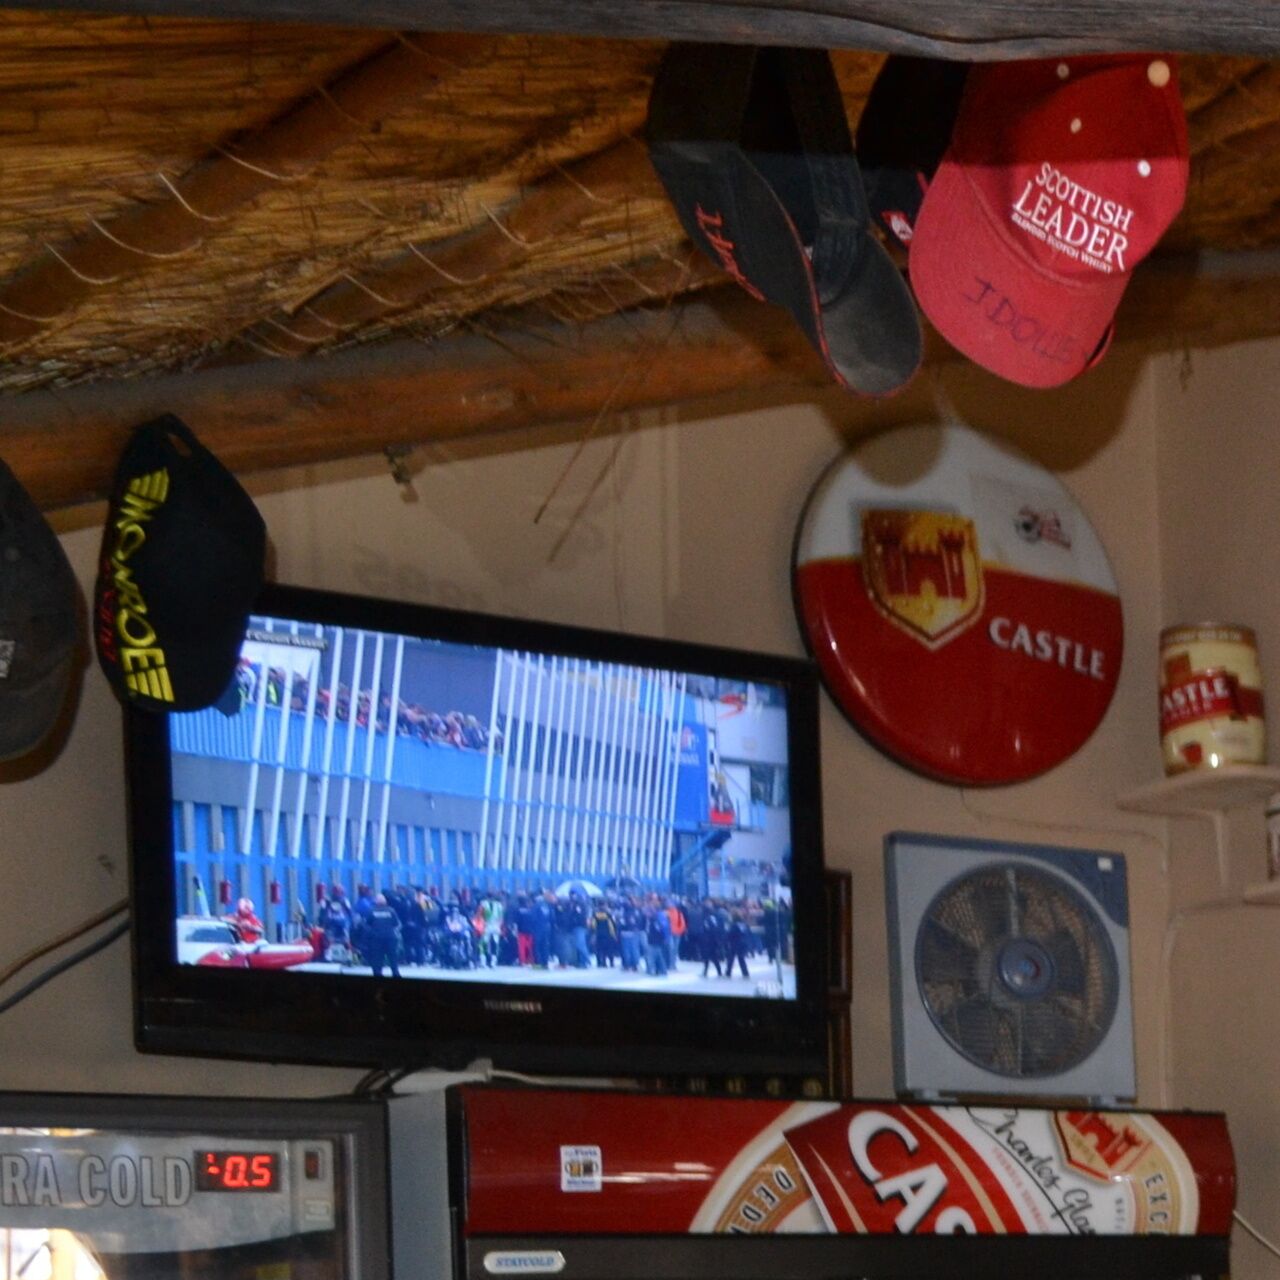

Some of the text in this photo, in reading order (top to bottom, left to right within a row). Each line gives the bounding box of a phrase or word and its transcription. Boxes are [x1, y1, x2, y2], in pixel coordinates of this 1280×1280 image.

[1012, 180, 1128, 272] LEADER
[1034, 160, 1134, 233] SCOTTISH
[112, 466, 174, 702] MONROE
[989, 616, 1105, 680] CASTLE
[78, 1156, 193, 1208] COLD
